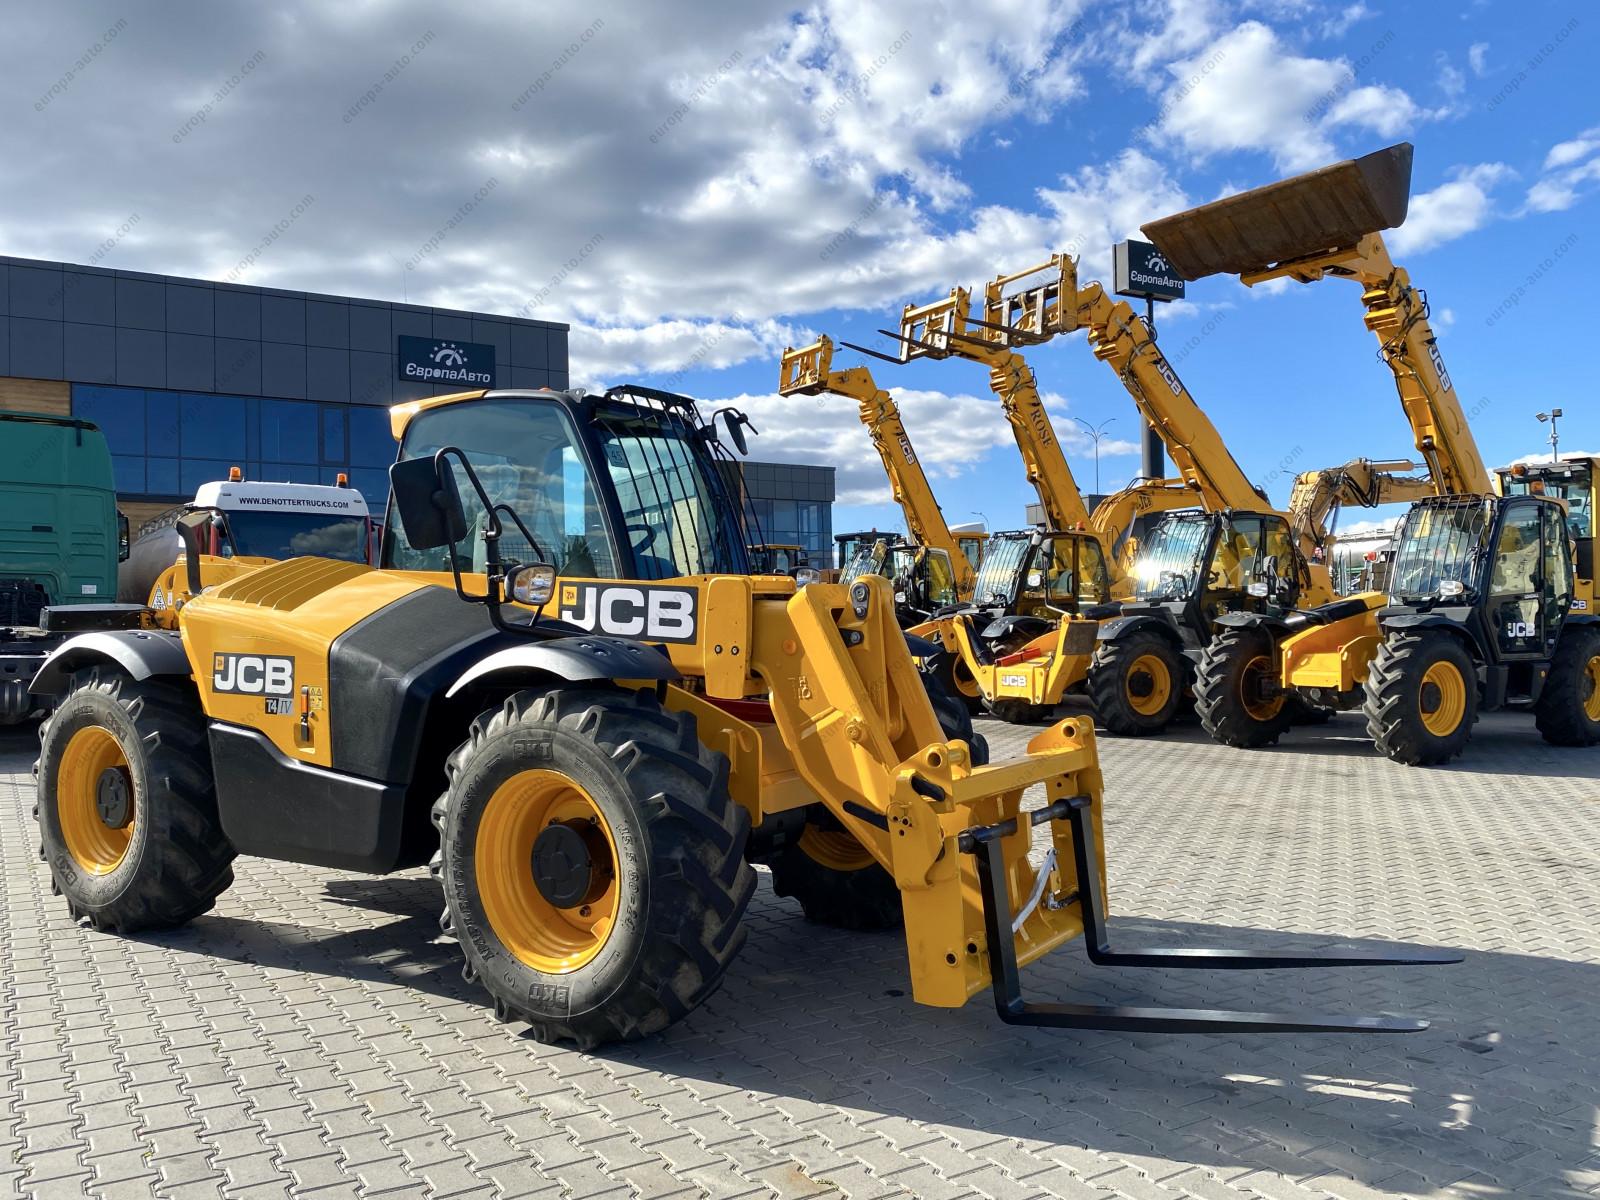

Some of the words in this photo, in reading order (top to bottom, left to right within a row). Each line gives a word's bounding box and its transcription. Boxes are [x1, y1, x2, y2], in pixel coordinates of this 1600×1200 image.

[1130, 270, 1184, 289] ЄвропаАвто
[405, 362, 491, 383] ЄвропаАвто
[1429, 345, 1451, 391] JCB
[1156, 362, 1182, 396] JCB
[899, 437, 915, 465] JCB
[239, 497, 349, 509] WWW.DENOTTERTRUCKS.COM
[561, 586, 694, 639] JCB
[1570, 600, 1587, 610] CB
[1507, 622, 1536, 638] JCB
[214, 656, 293, 695] JCB
[1002, 675, 1027, 687] JCB
